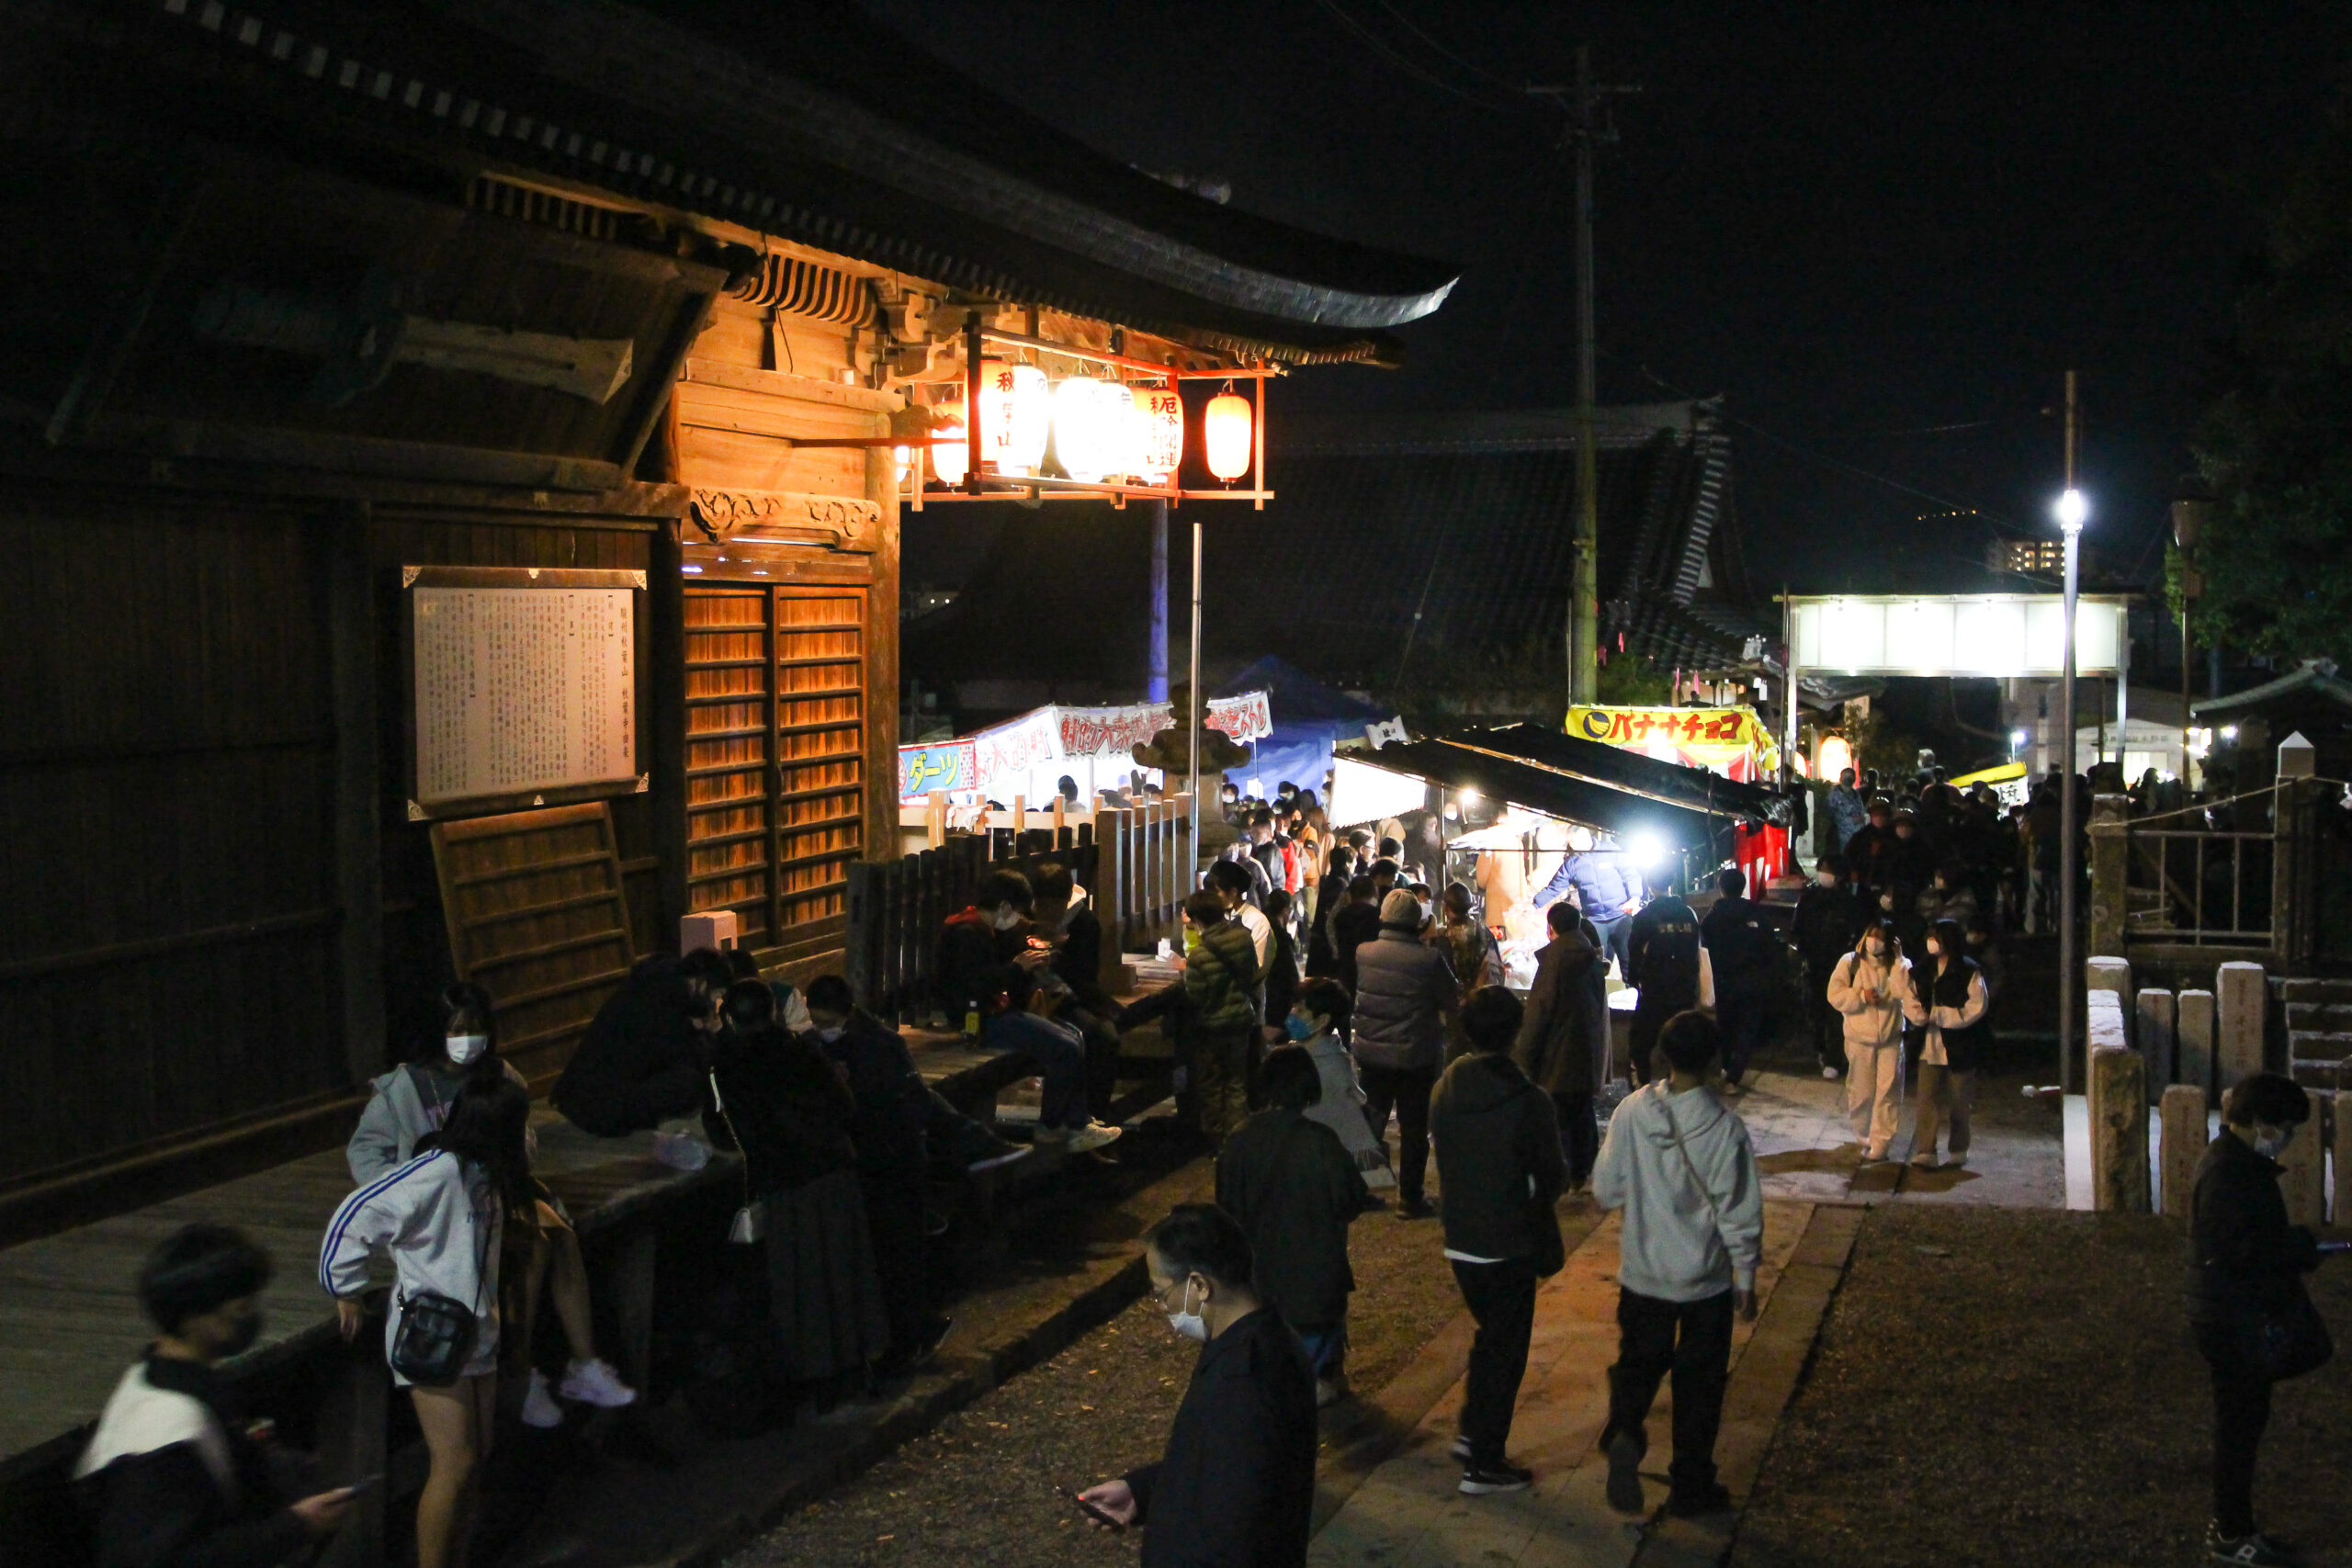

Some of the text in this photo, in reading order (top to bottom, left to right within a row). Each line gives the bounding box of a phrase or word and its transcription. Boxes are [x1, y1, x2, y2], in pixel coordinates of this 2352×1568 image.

[1609, 712, 1744, 740] バナナチョコ
[909, 751, 958, 793] ダーツ
